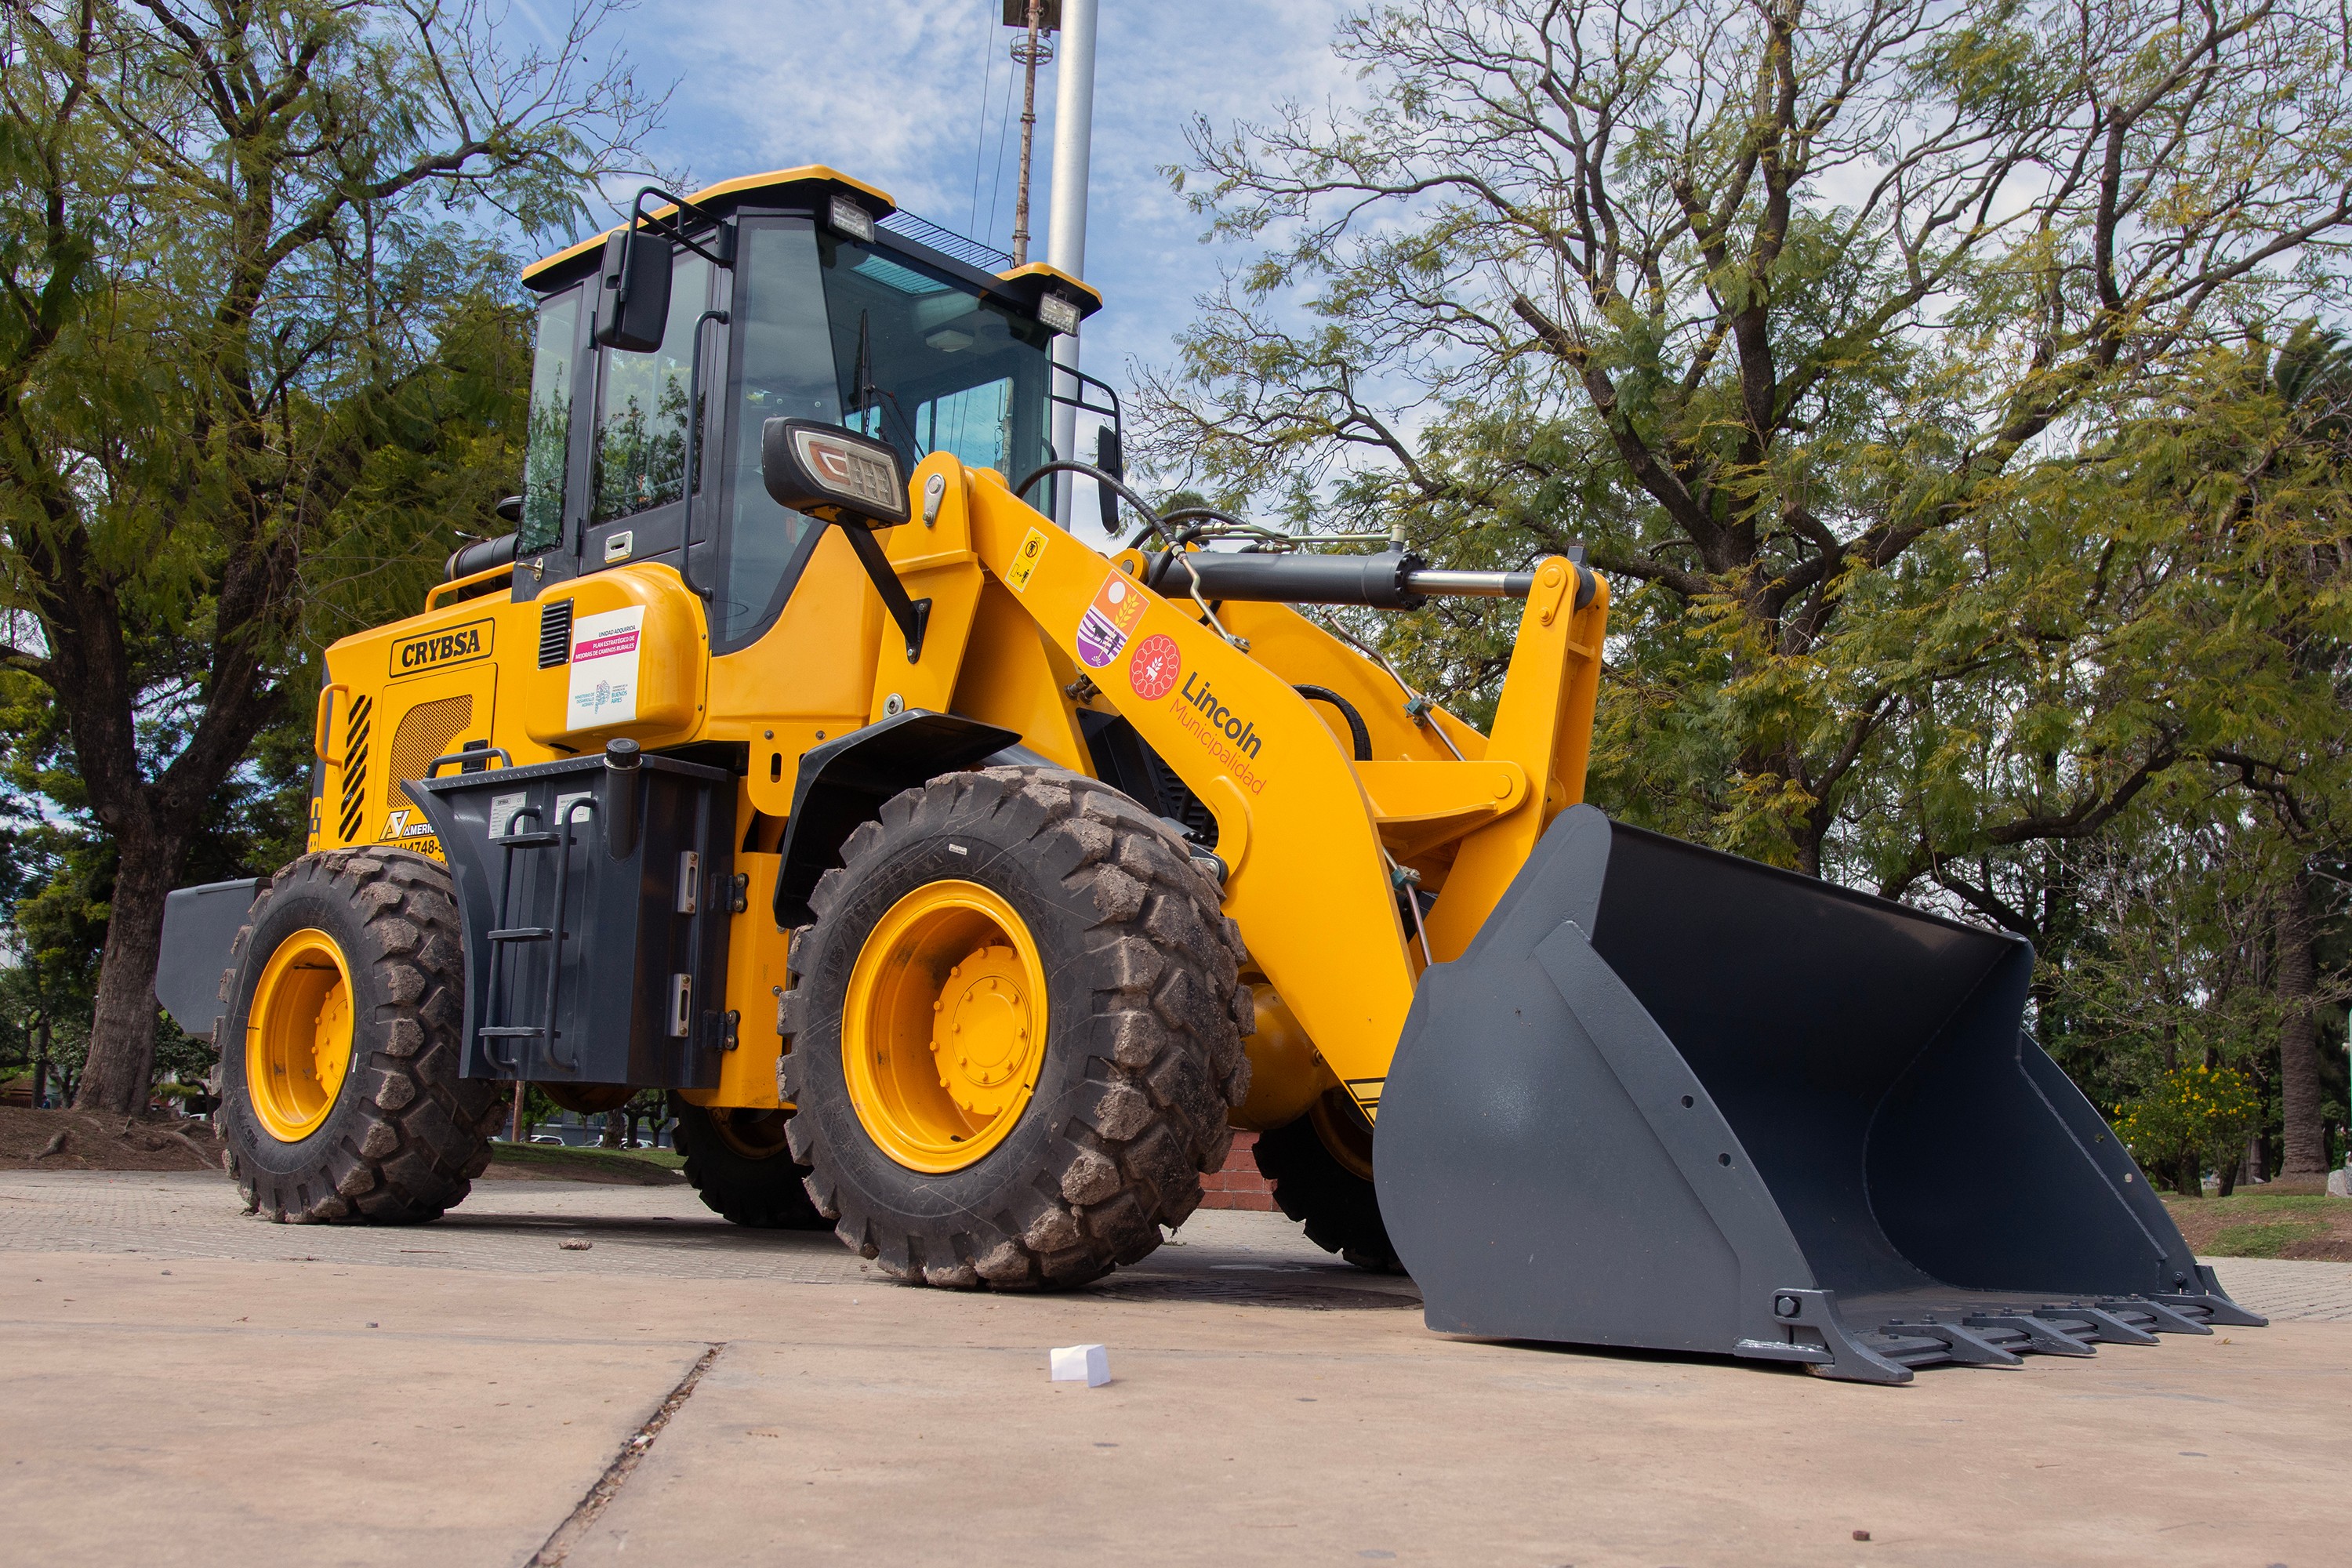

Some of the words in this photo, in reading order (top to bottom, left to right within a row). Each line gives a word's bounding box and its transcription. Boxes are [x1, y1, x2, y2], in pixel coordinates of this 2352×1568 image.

[604, 637, 629, 647] ESTRATÉGICO
[614, 625, 636, 635] ADQUIRIDA
[401, 630, 481, 668] CRYBSA
[575, 651, 593, 660] MEJORAS
[598, 646, 616, 655] CAMINOS
[1181, 672, 1262, 760] Lincoln
[1169, 697, 1267, 796] Municipalidad
